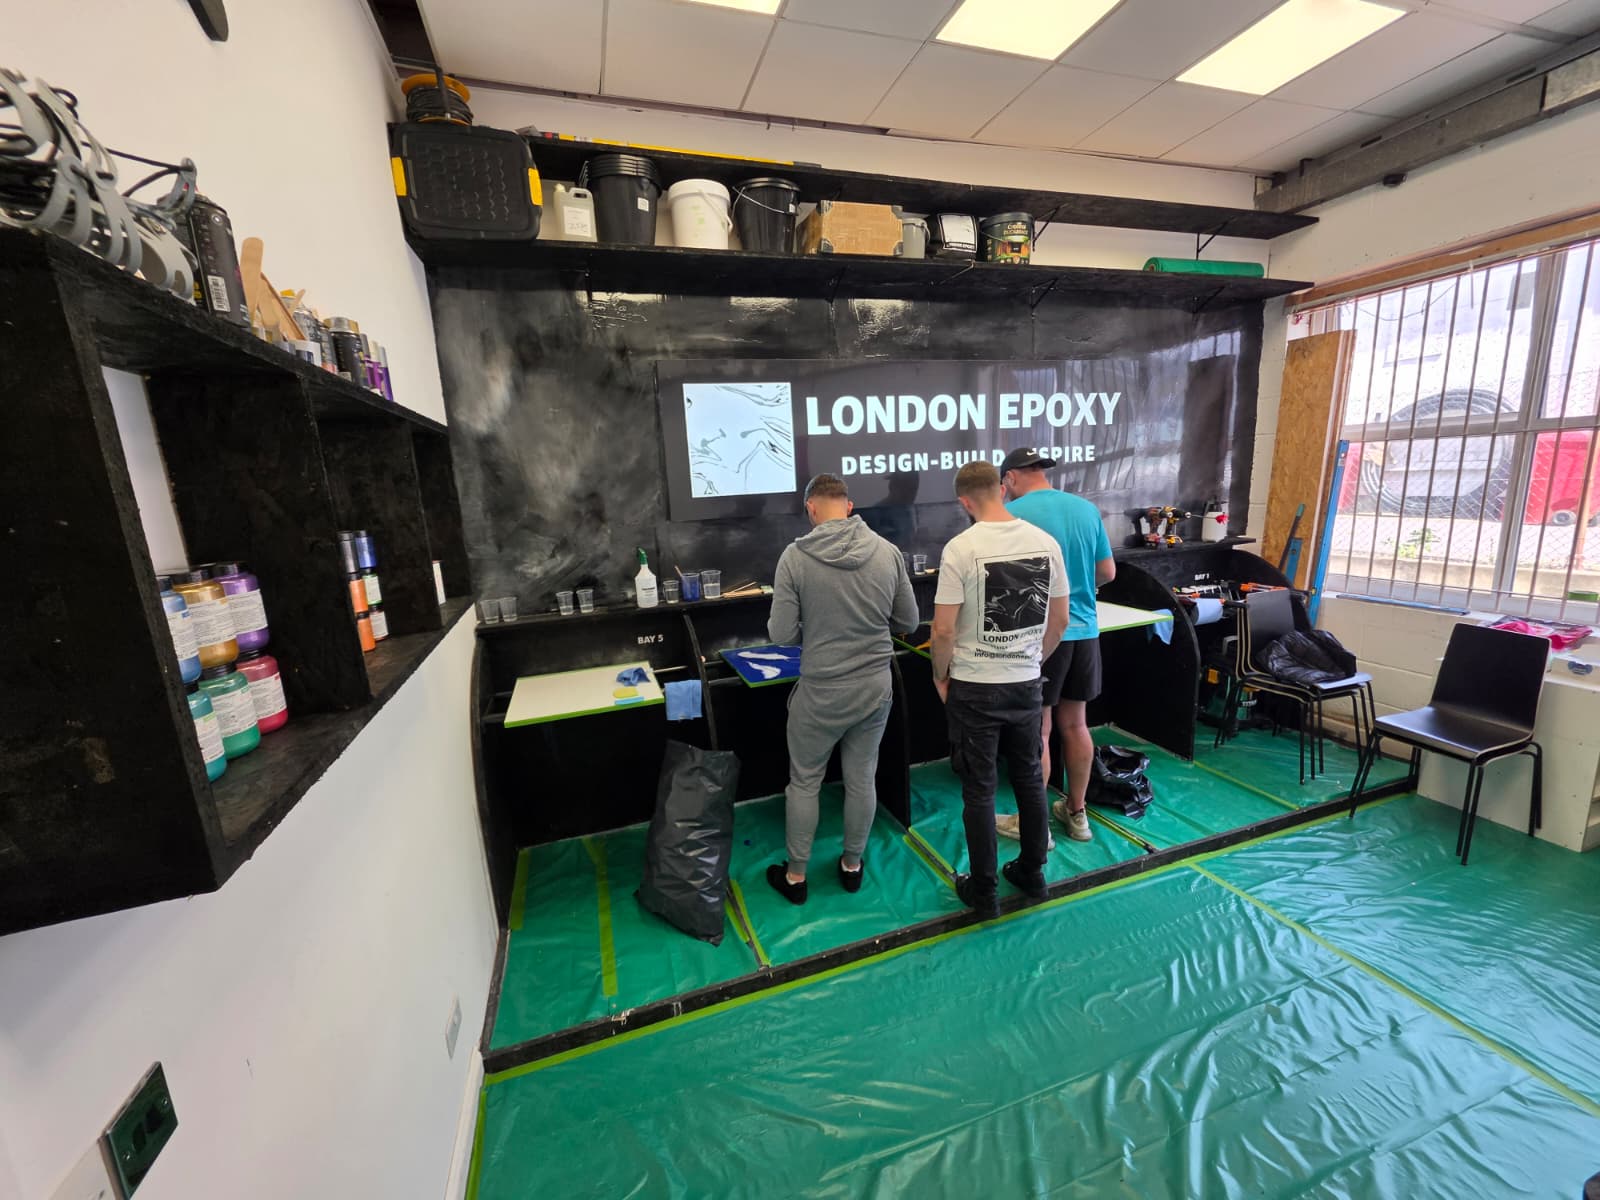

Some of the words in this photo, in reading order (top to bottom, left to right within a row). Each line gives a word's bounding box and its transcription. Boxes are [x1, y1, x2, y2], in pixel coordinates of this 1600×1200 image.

[806, 395, 986, 435] LONDON
[999, 391, 1121, 430] EPOXY
[637, 635, 656, 645] BAY
[657, 634, 664, 642] 5
[983, 634, 1018, 643] LONDON
